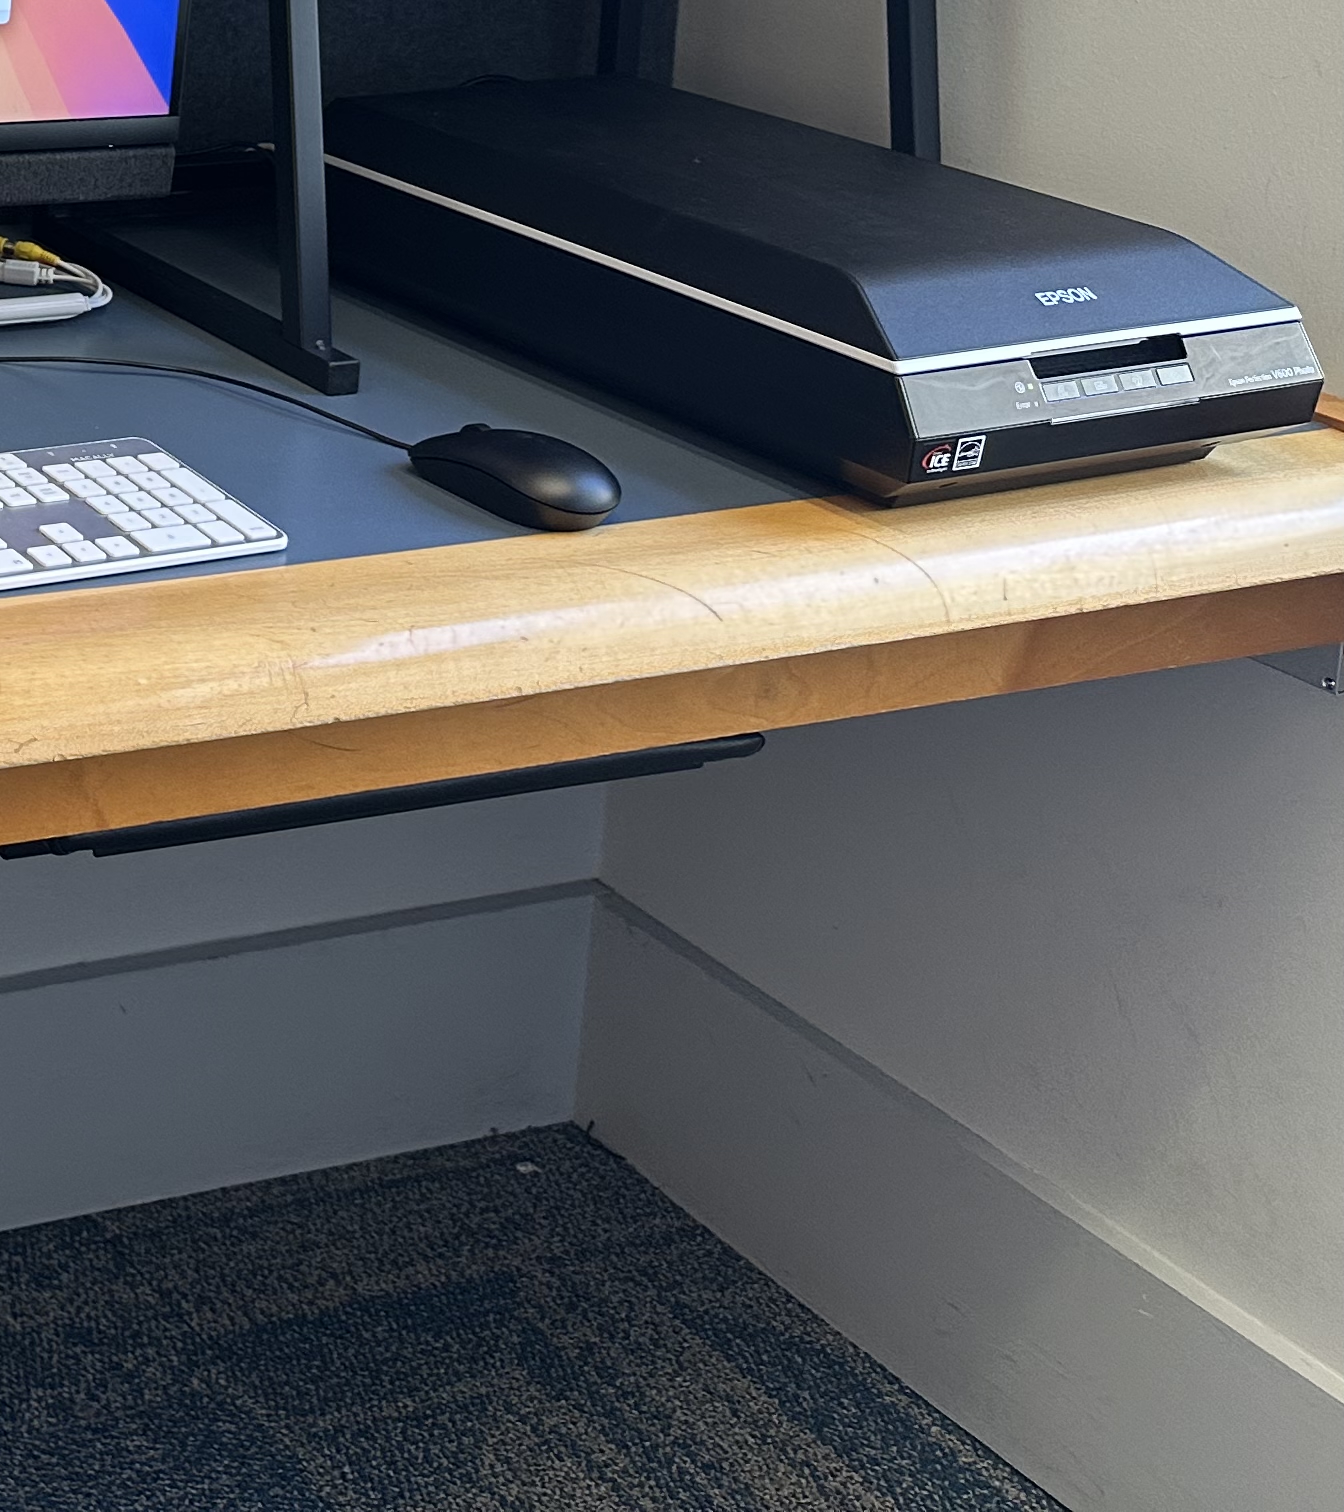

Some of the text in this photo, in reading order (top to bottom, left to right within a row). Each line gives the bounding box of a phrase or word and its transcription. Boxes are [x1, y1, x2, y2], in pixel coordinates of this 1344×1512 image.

[1034, 287, 1097, 308] EPSON
[1270, 367, 1293, 380] V600
[929, 453, 952, 468] ICE
